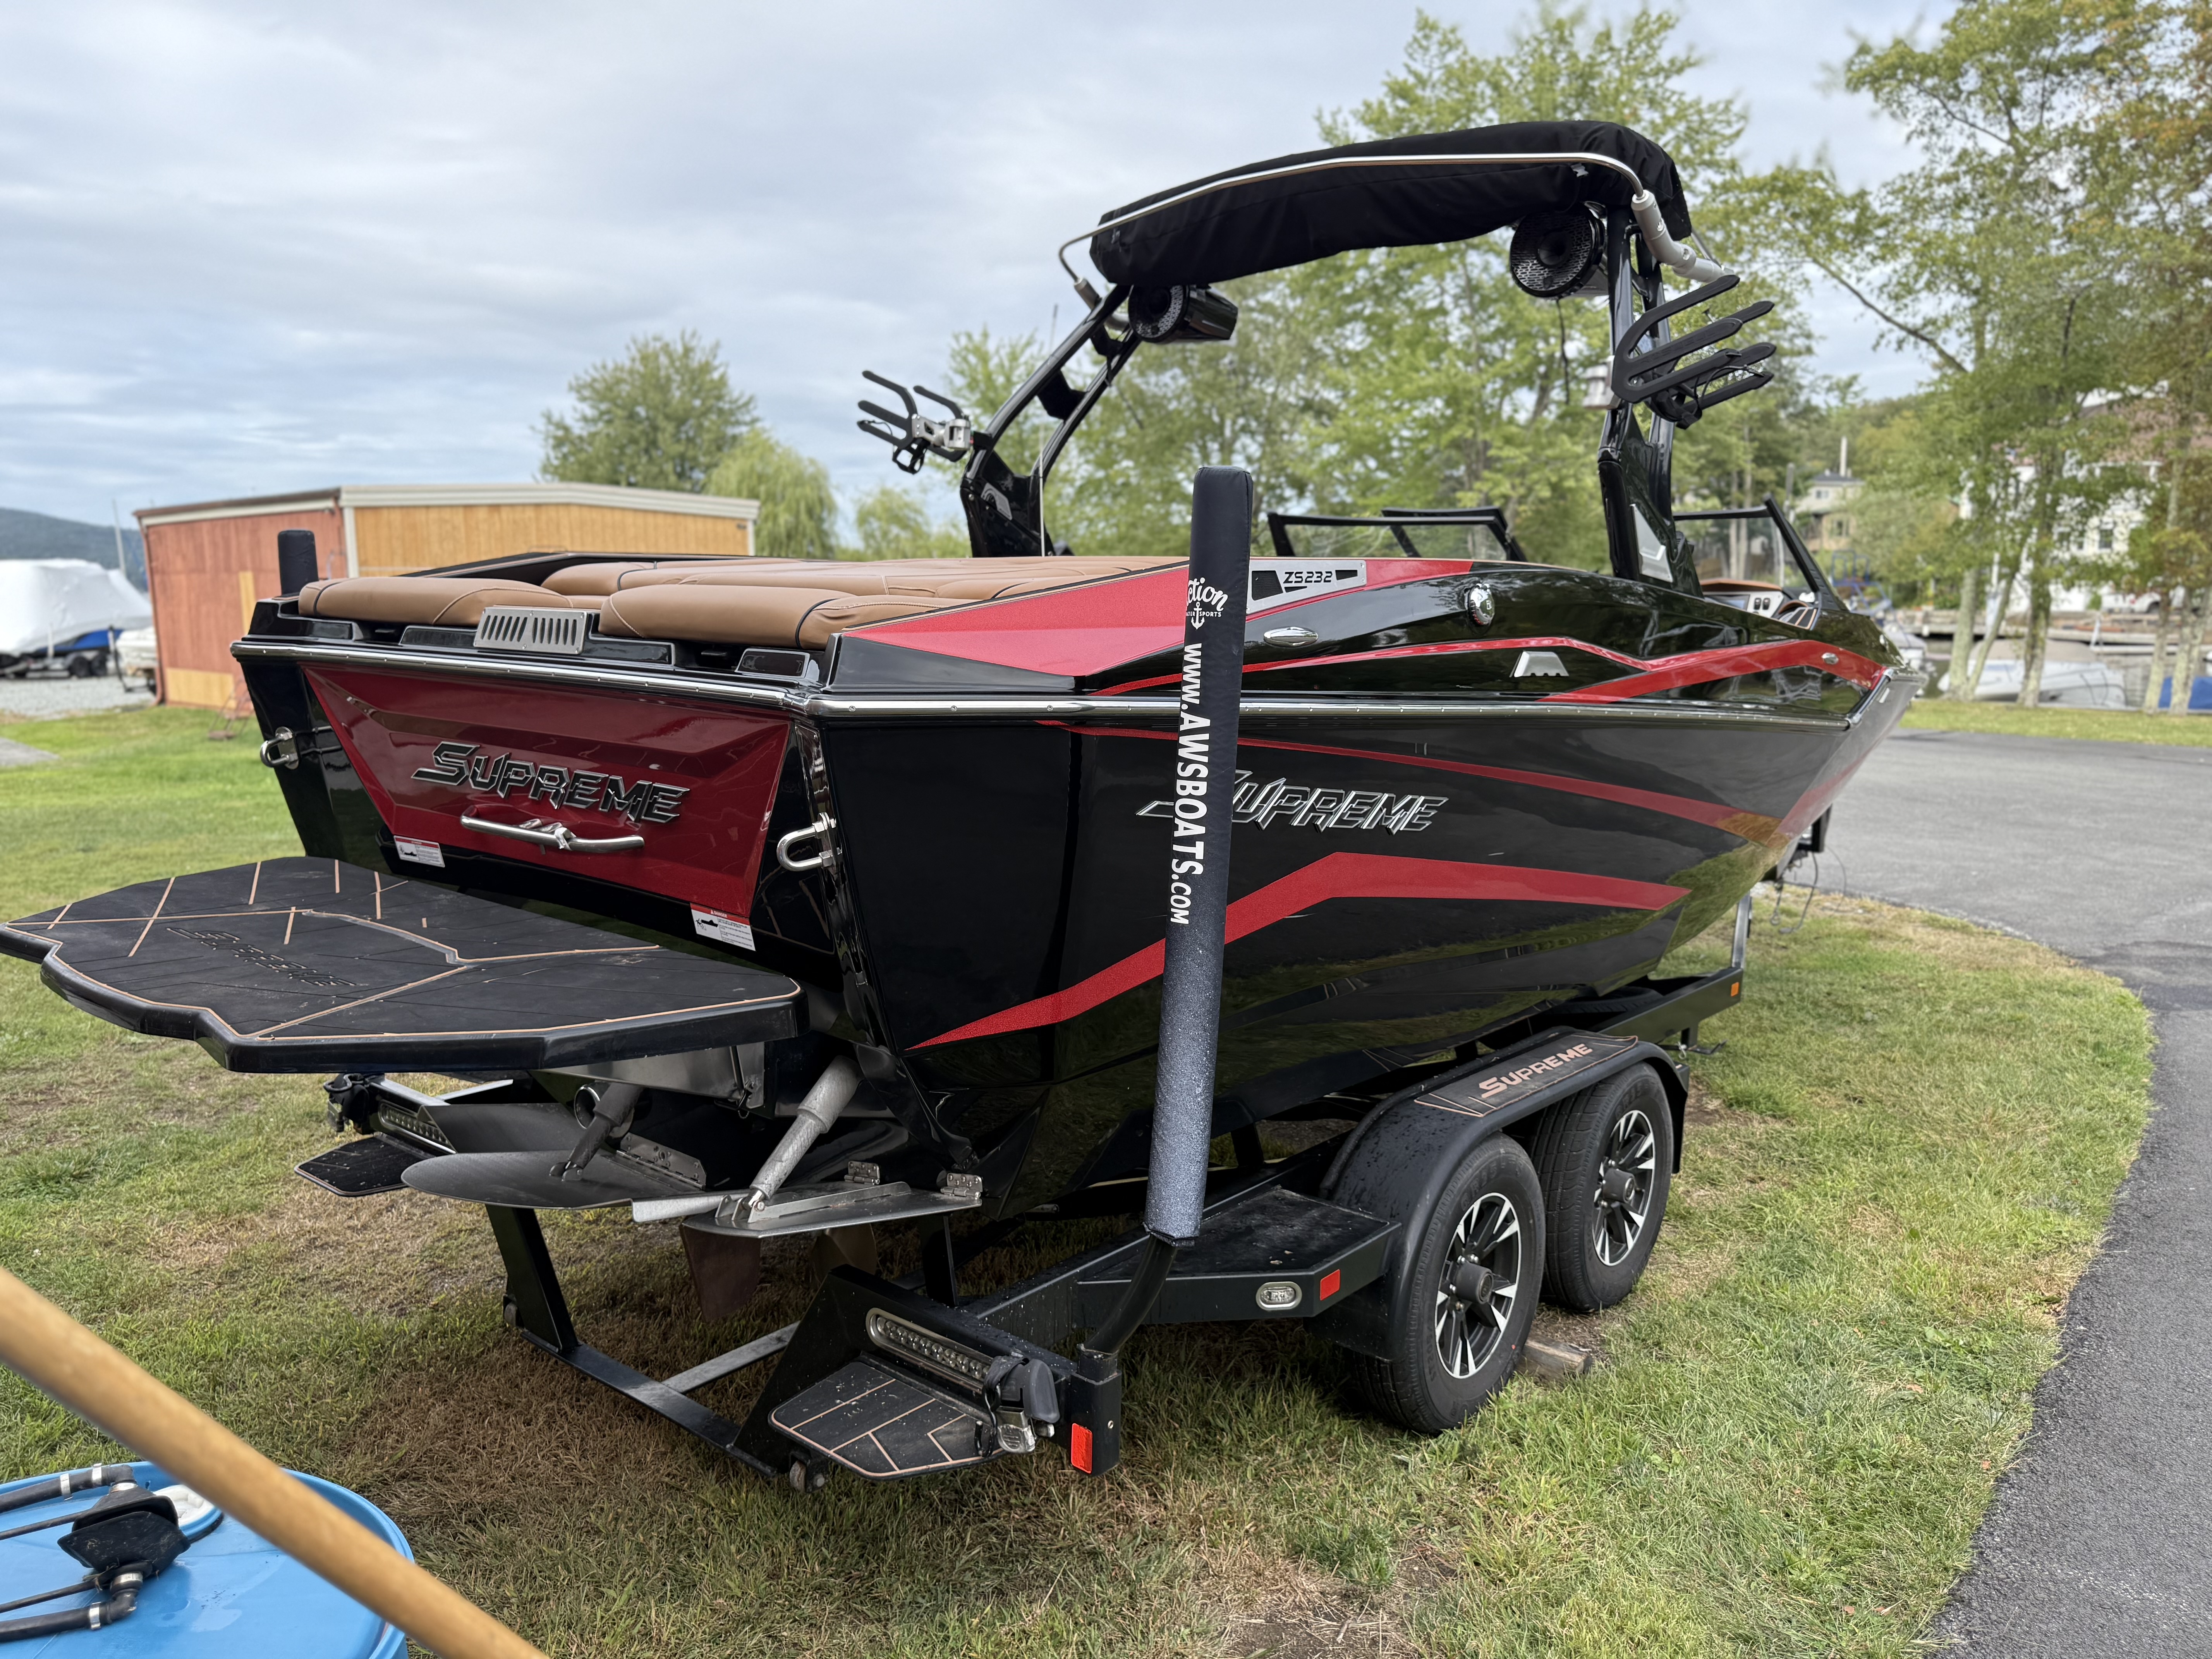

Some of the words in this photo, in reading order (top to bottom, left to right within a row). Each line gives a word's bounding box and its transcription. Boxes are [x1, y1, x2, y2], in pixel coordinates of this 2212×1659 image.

[1187, 577, 1228, 611] ction
[1283, 571, 1333, 584] ZS232
[410, 741, 690, 823] SUPREME
[1479, 1043, 1593, 1099] SUPREME
